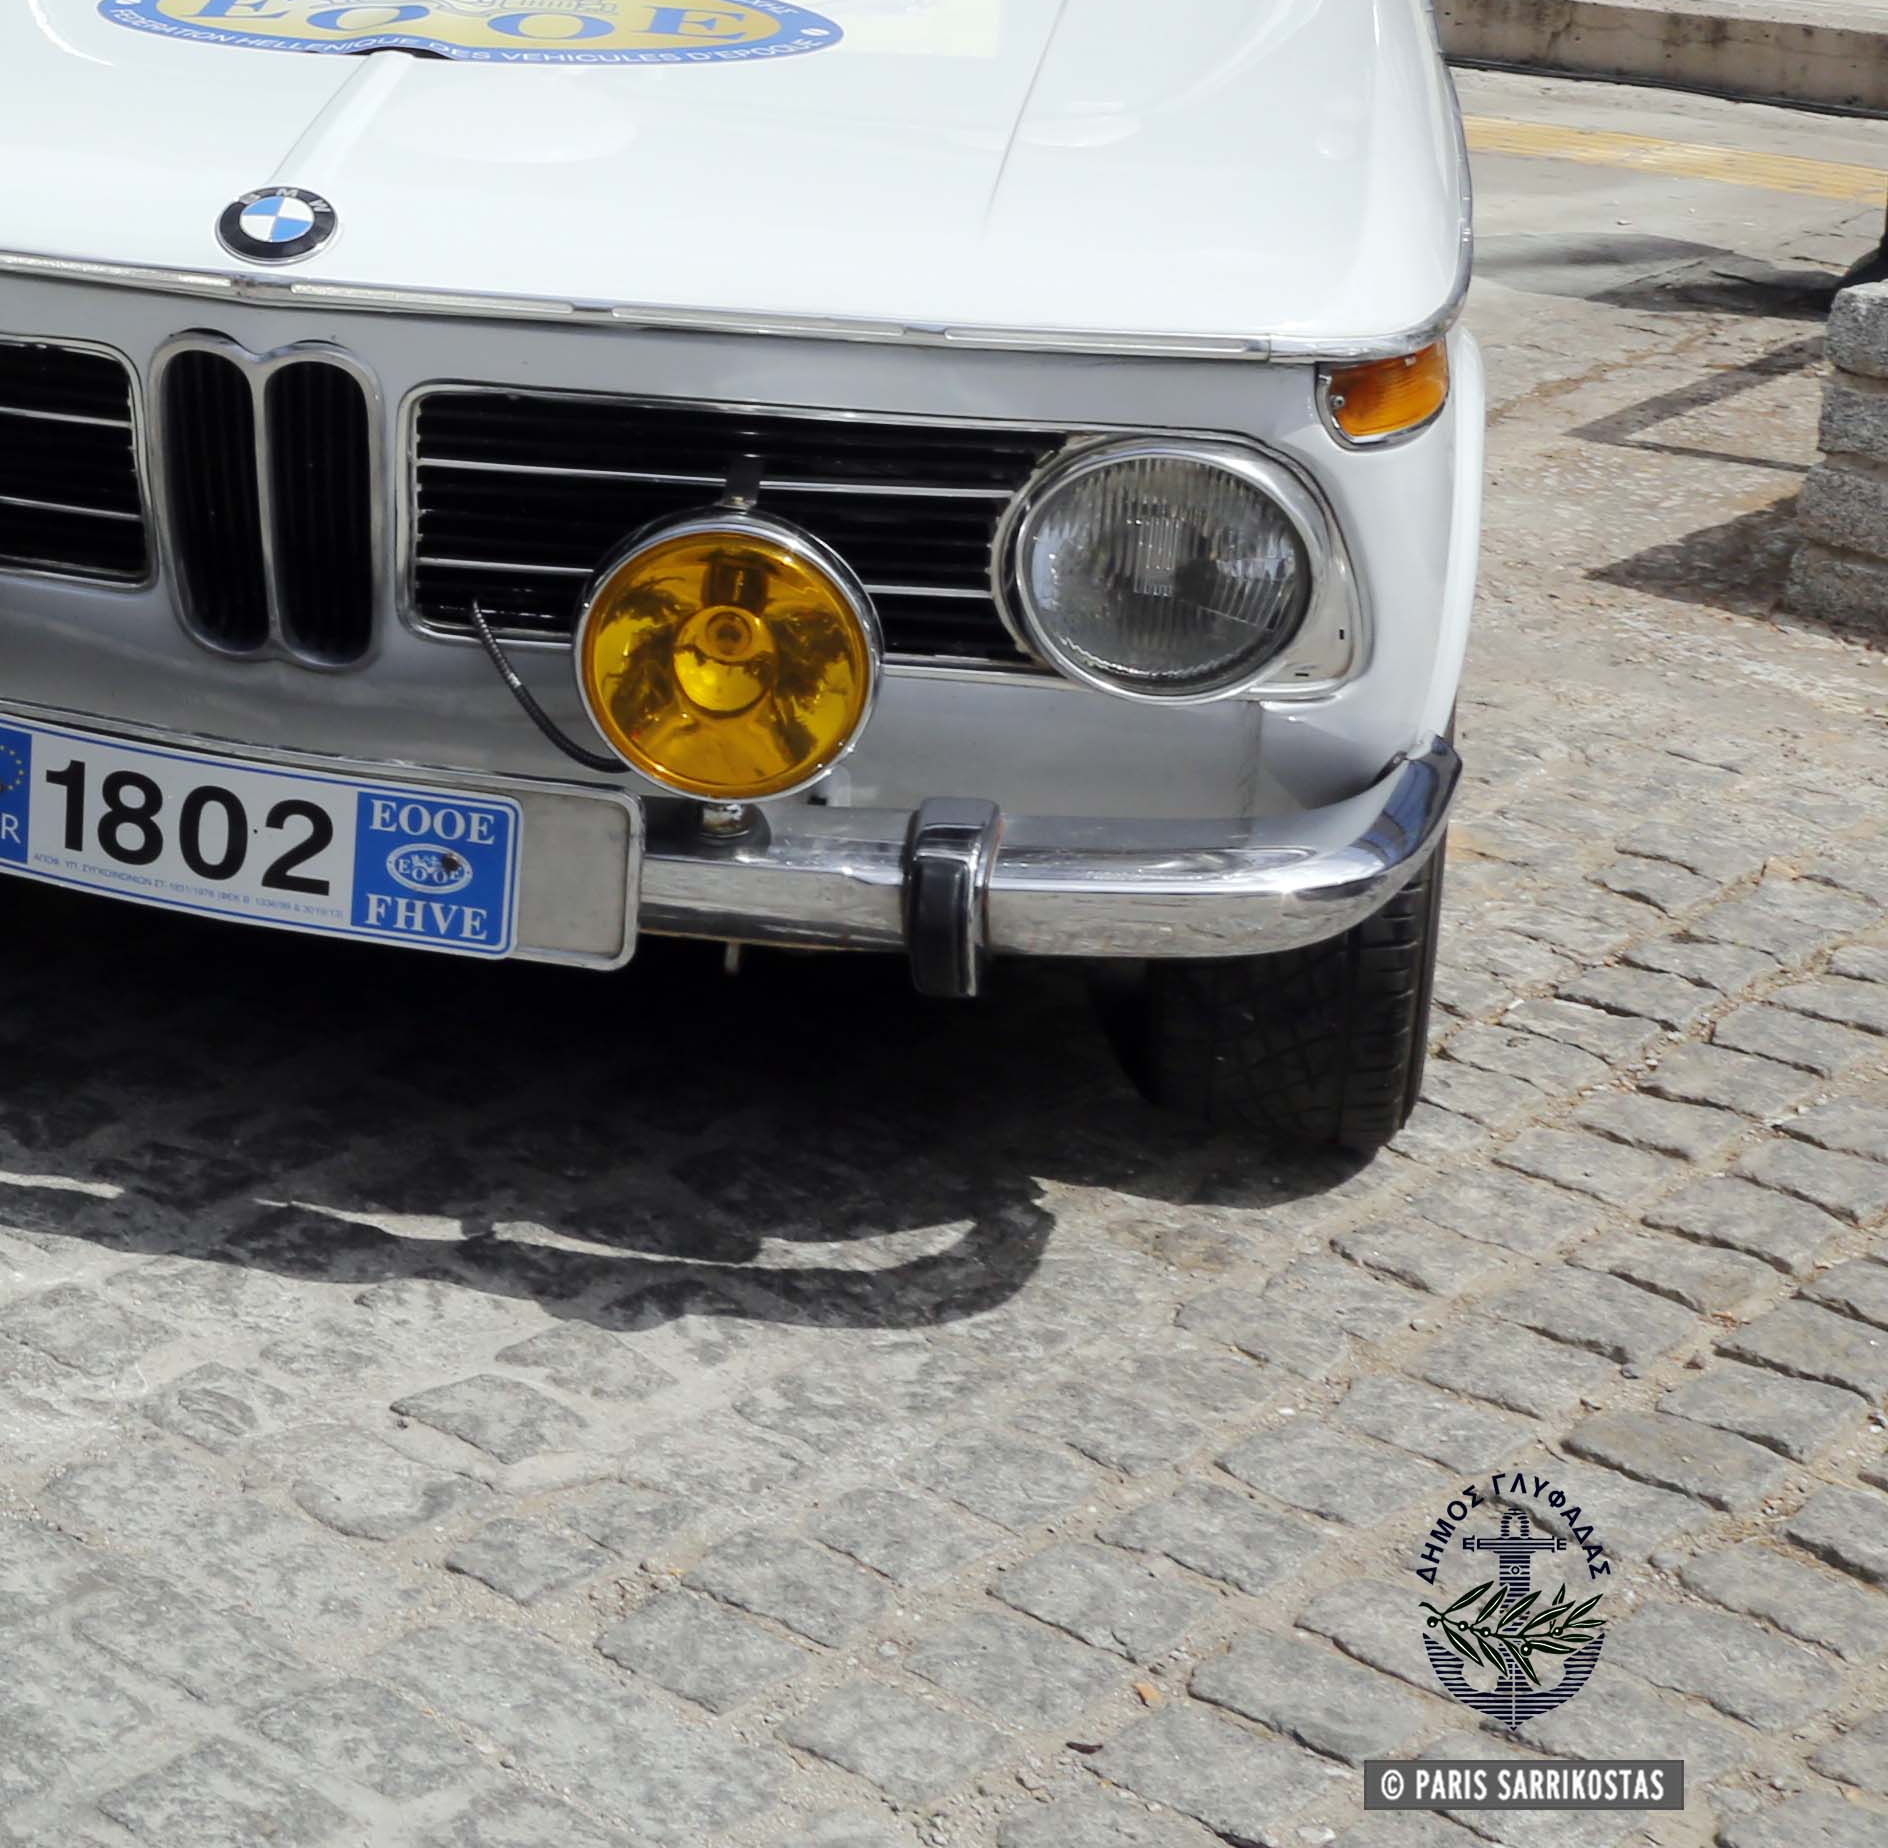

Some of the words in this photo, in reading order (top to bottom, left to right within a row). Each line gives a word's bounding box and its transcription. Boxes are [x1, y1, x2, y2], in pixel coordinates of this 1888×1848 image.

[110, 8, 226, 44] FEDERATION
[501, 50, 676, 64] VEHICULES
[45, 759, 334, 897] 1802
[369, 798, 496, 847] EOOE
[366, 894, 489, 942] FHVE
